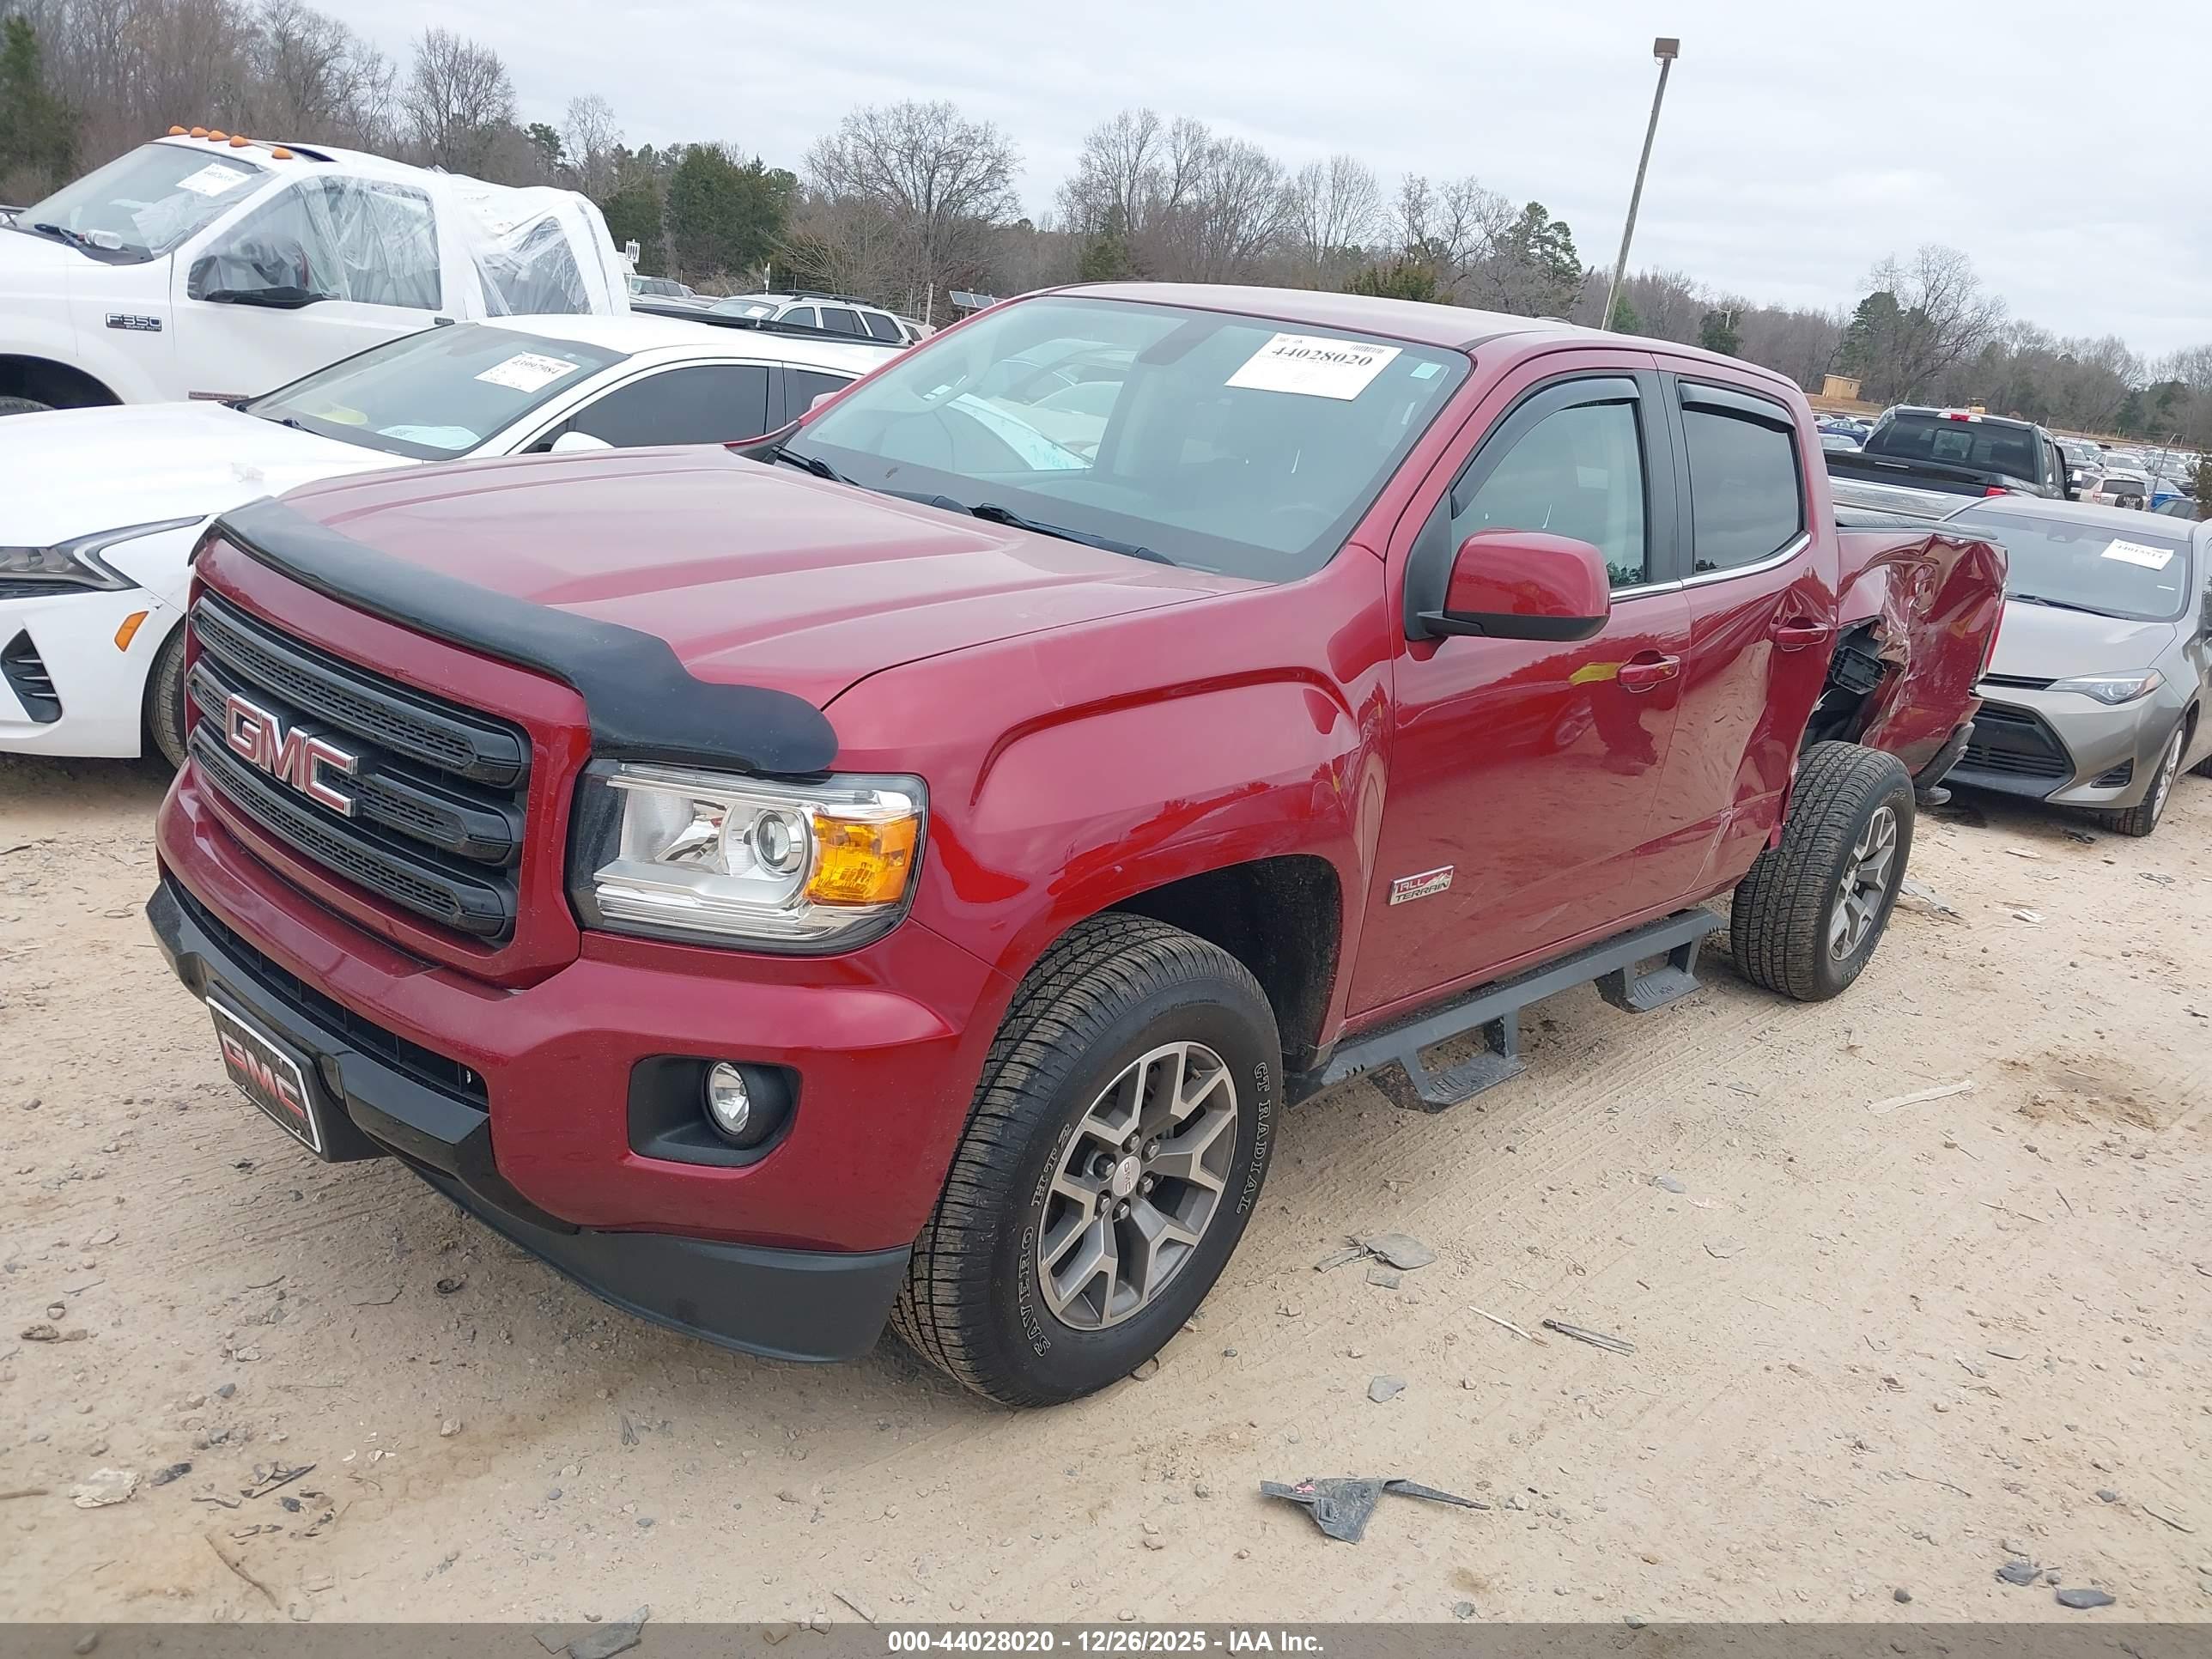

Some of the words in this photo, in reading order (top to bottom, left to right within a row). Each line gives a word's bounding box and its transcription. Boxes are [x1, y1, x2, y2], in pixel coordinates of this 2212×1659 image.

[1271, 345, 1373, 367] 44028020
[225, 692, 360, 817] GMC
[1395, 881, 1449, 902] TERRAIN
[1400, 878, 1425, 891] ALL
[221, 1027, 308, 1121] GMC
[1254, 1061, 1271, 1092] GT
[1236, 1099, 1271, 1214] RADIAL
[1018, 1225, 1052, 1358] SAVERO
